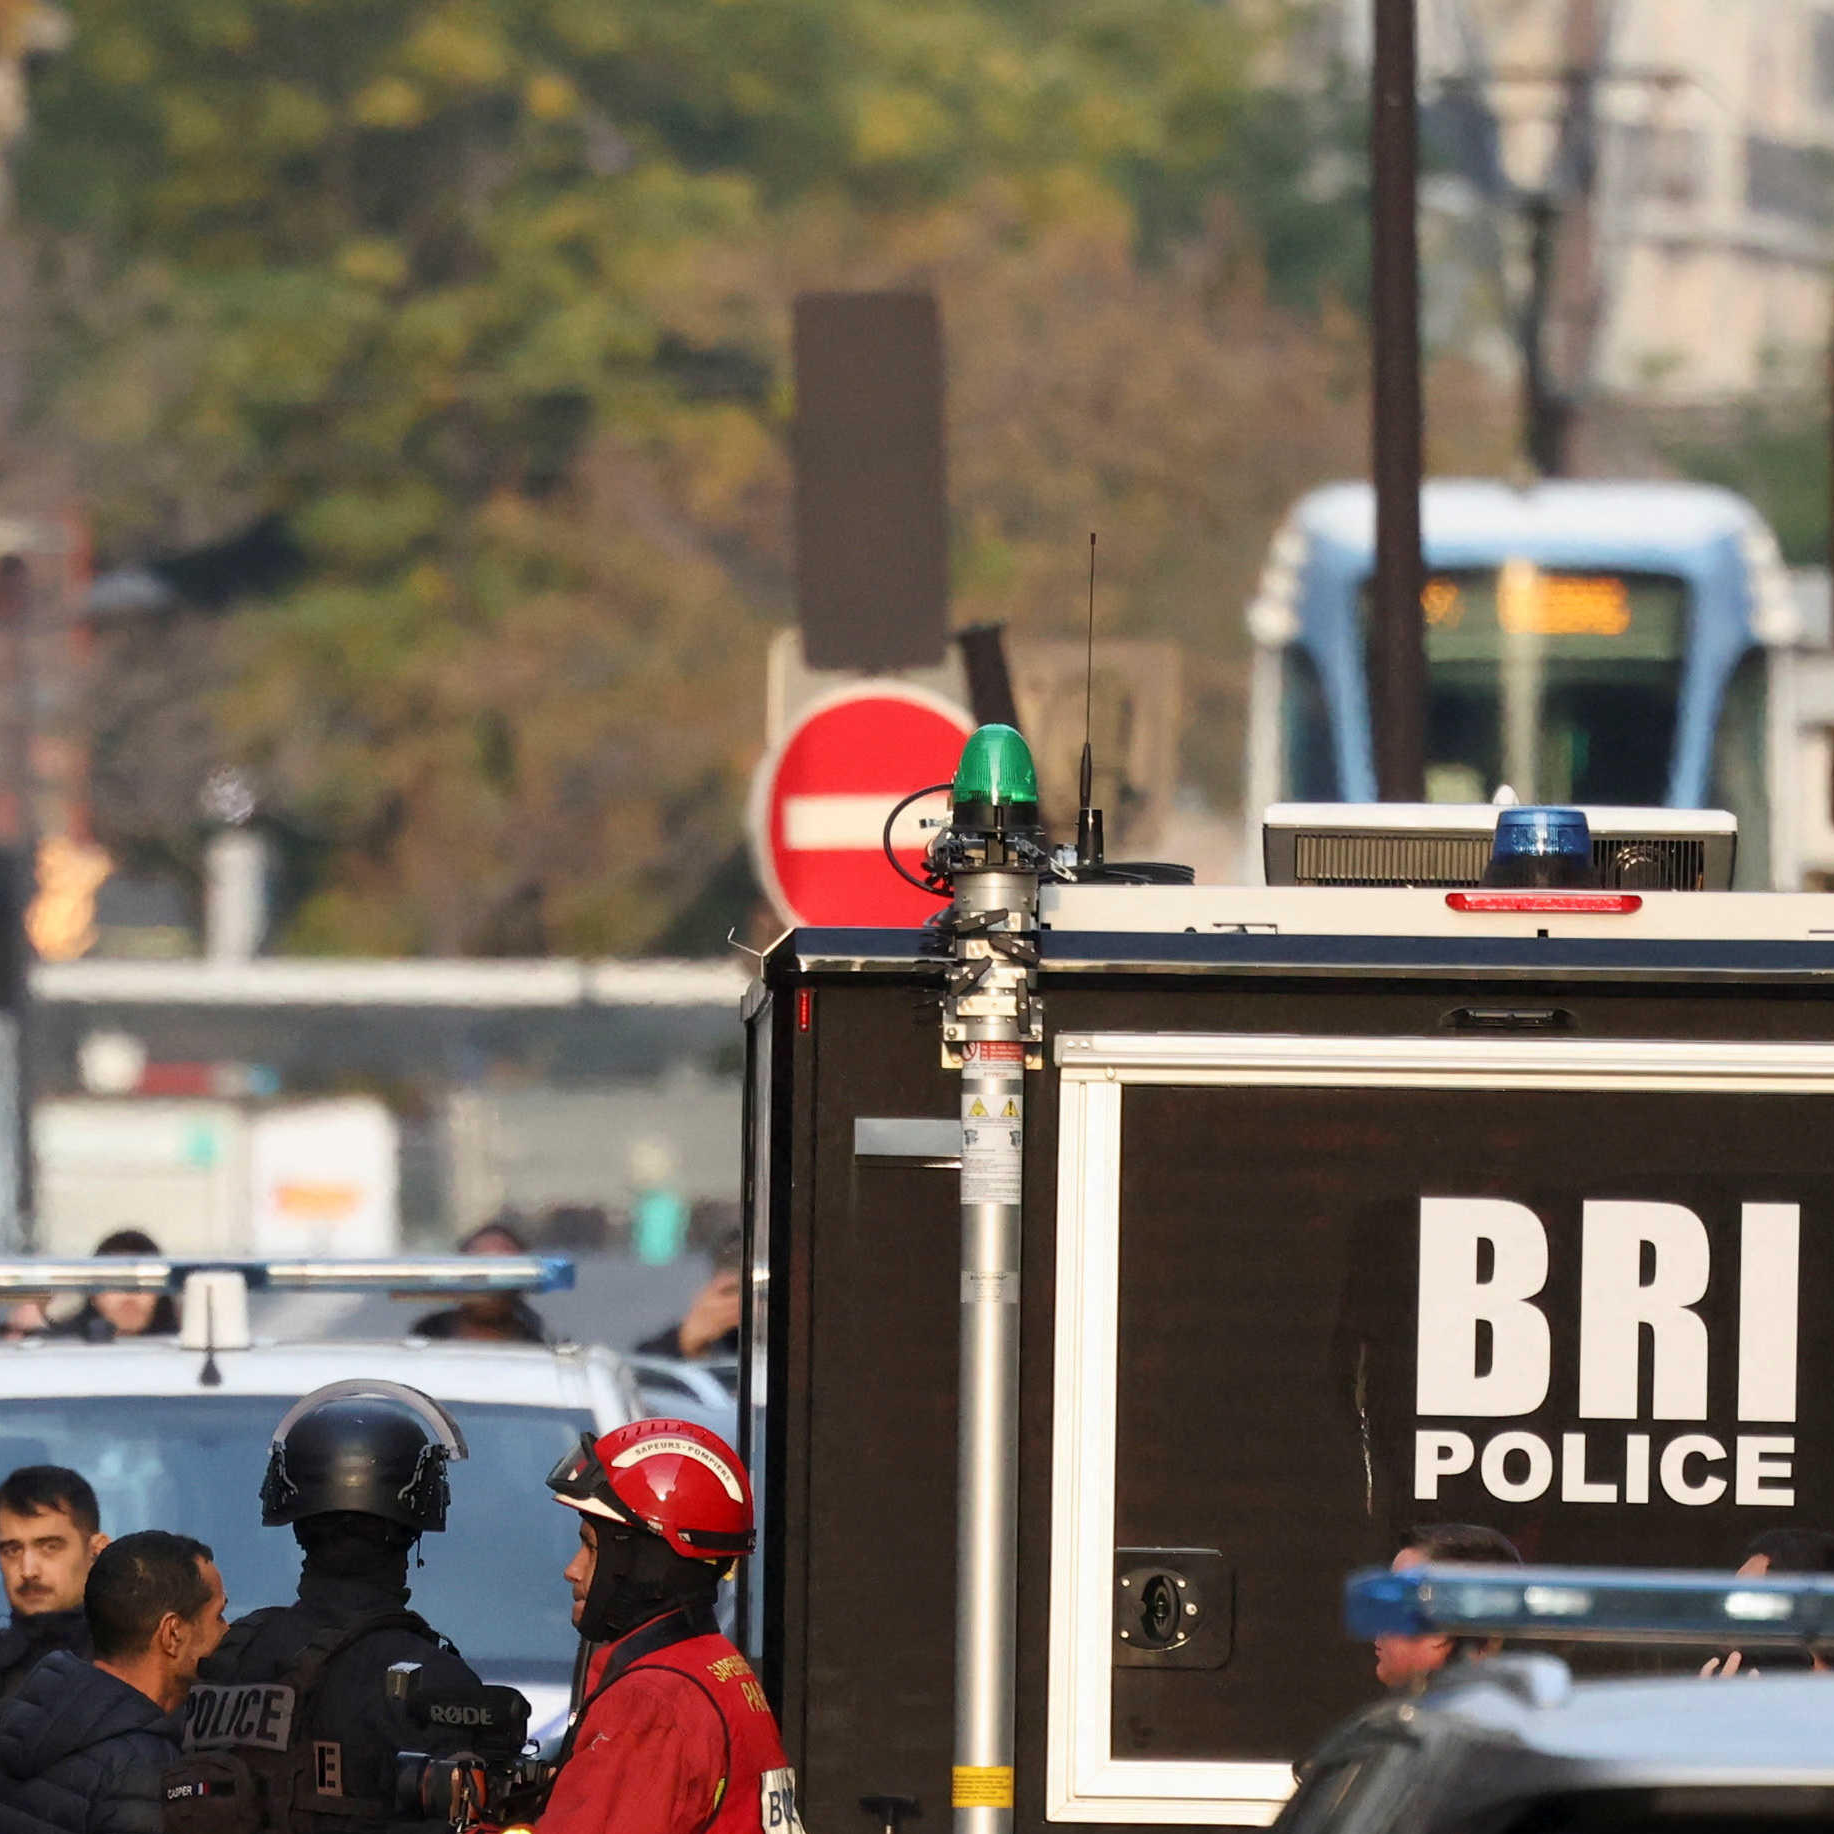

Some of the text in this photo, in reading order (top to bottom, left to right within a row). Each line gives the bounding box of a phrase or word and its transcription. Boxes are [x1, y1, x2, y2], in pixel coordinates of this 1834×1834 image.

[1416, 1196, 1800, 1423] BRI
[634, 1441, 732, 1483] SAPEURS-POMPIERS
[1414, 1429, 1795, 1506] POLICE
[185, 1687, 286, 1743] POLICE
[430, 1704, 494, 1726] RØDE
